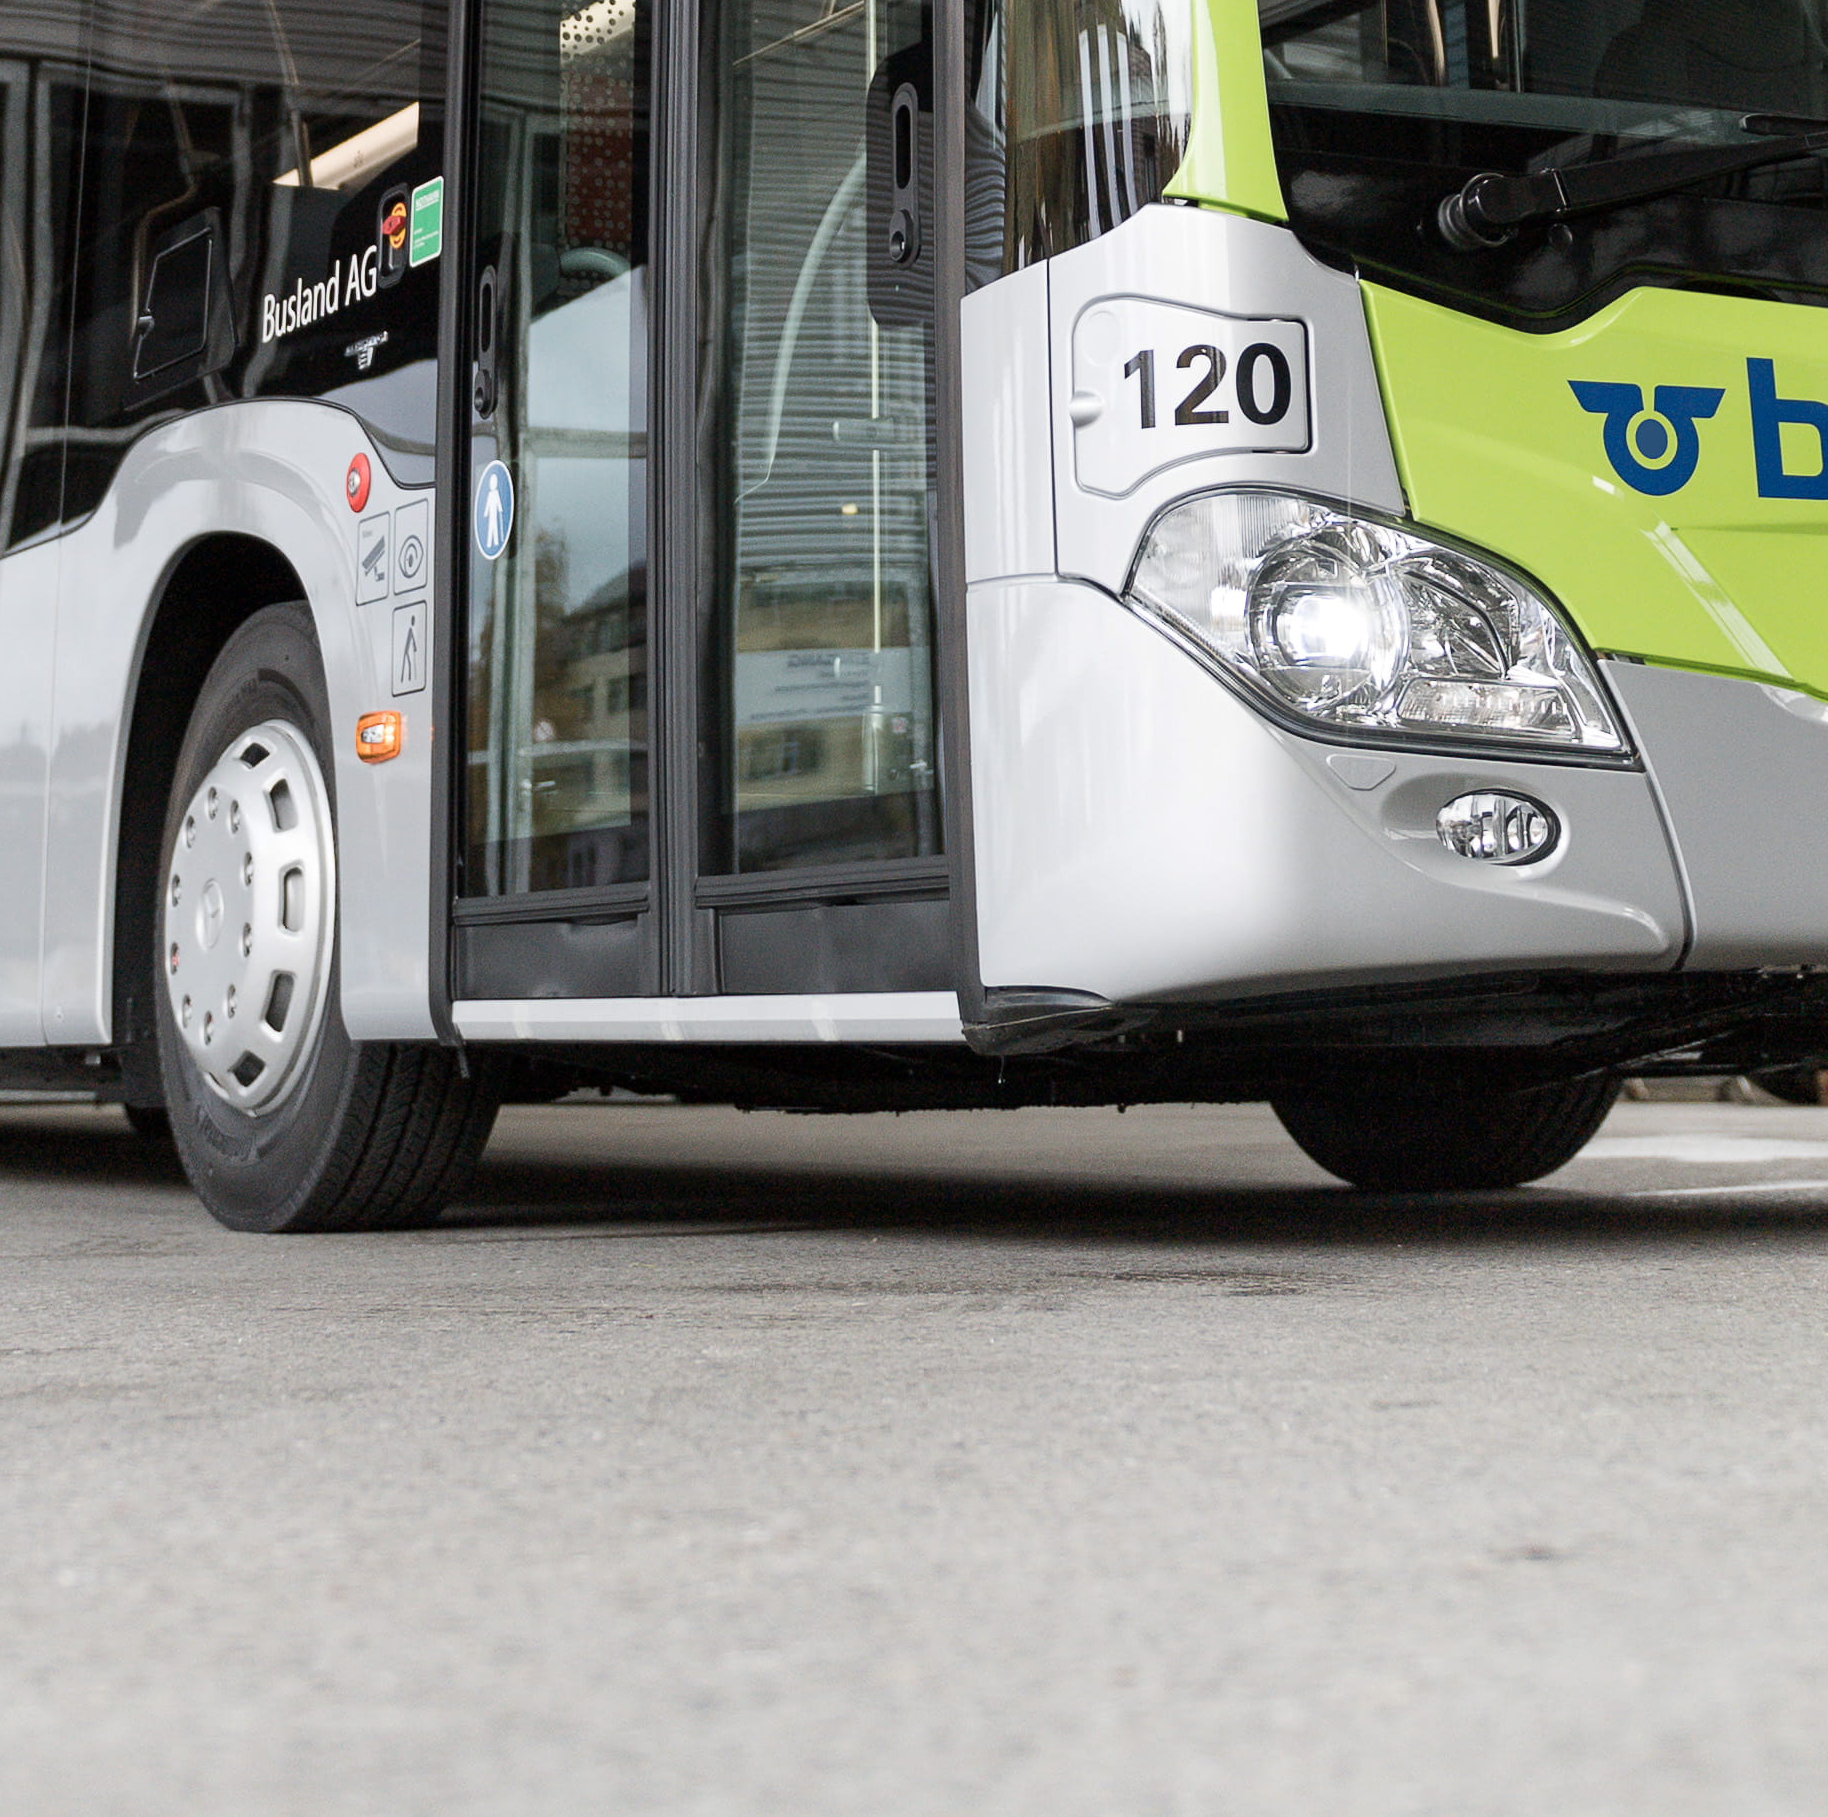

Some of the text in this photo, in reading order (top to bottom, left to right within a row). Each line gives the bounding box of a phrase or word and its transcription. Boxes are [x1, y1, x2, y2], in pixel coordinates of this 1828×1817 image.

[262, 244, 377, 344] Busland AG
[1124, 342, 1291, 429] 120
